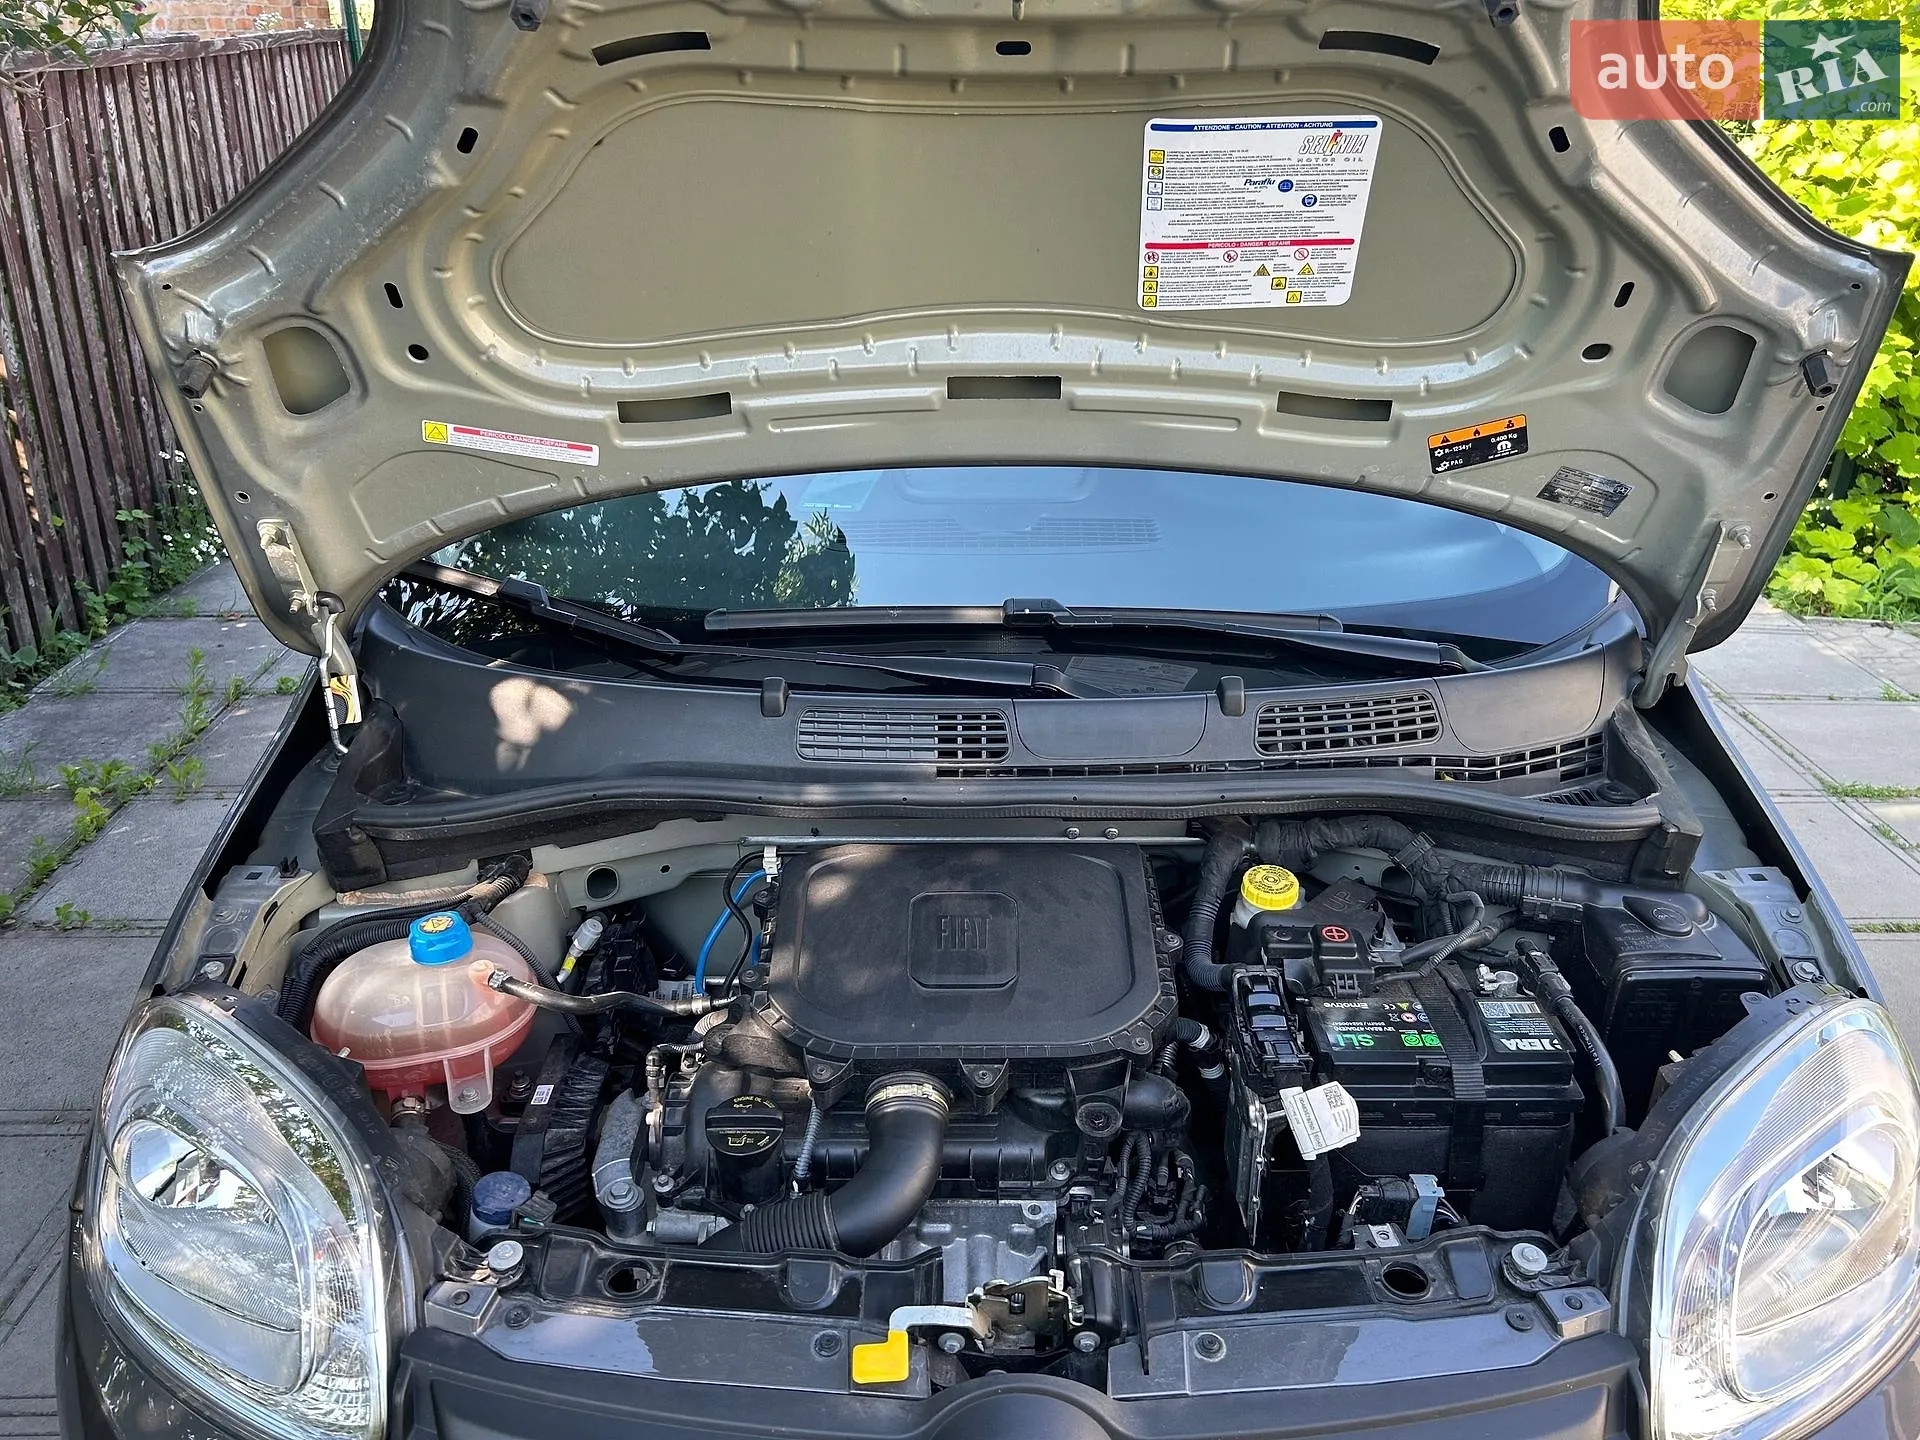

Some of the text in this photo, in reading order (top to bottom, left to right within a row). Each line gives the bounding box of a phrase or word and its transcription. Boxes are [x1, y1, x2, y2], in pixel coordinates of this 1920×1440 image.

[1450, 458, 1463, 466] PAG
[1324, 888, 1352, 911] UP
[937, 914, 992, 951] FIAT
[1336, 1033, 1375, 1046] SLI
